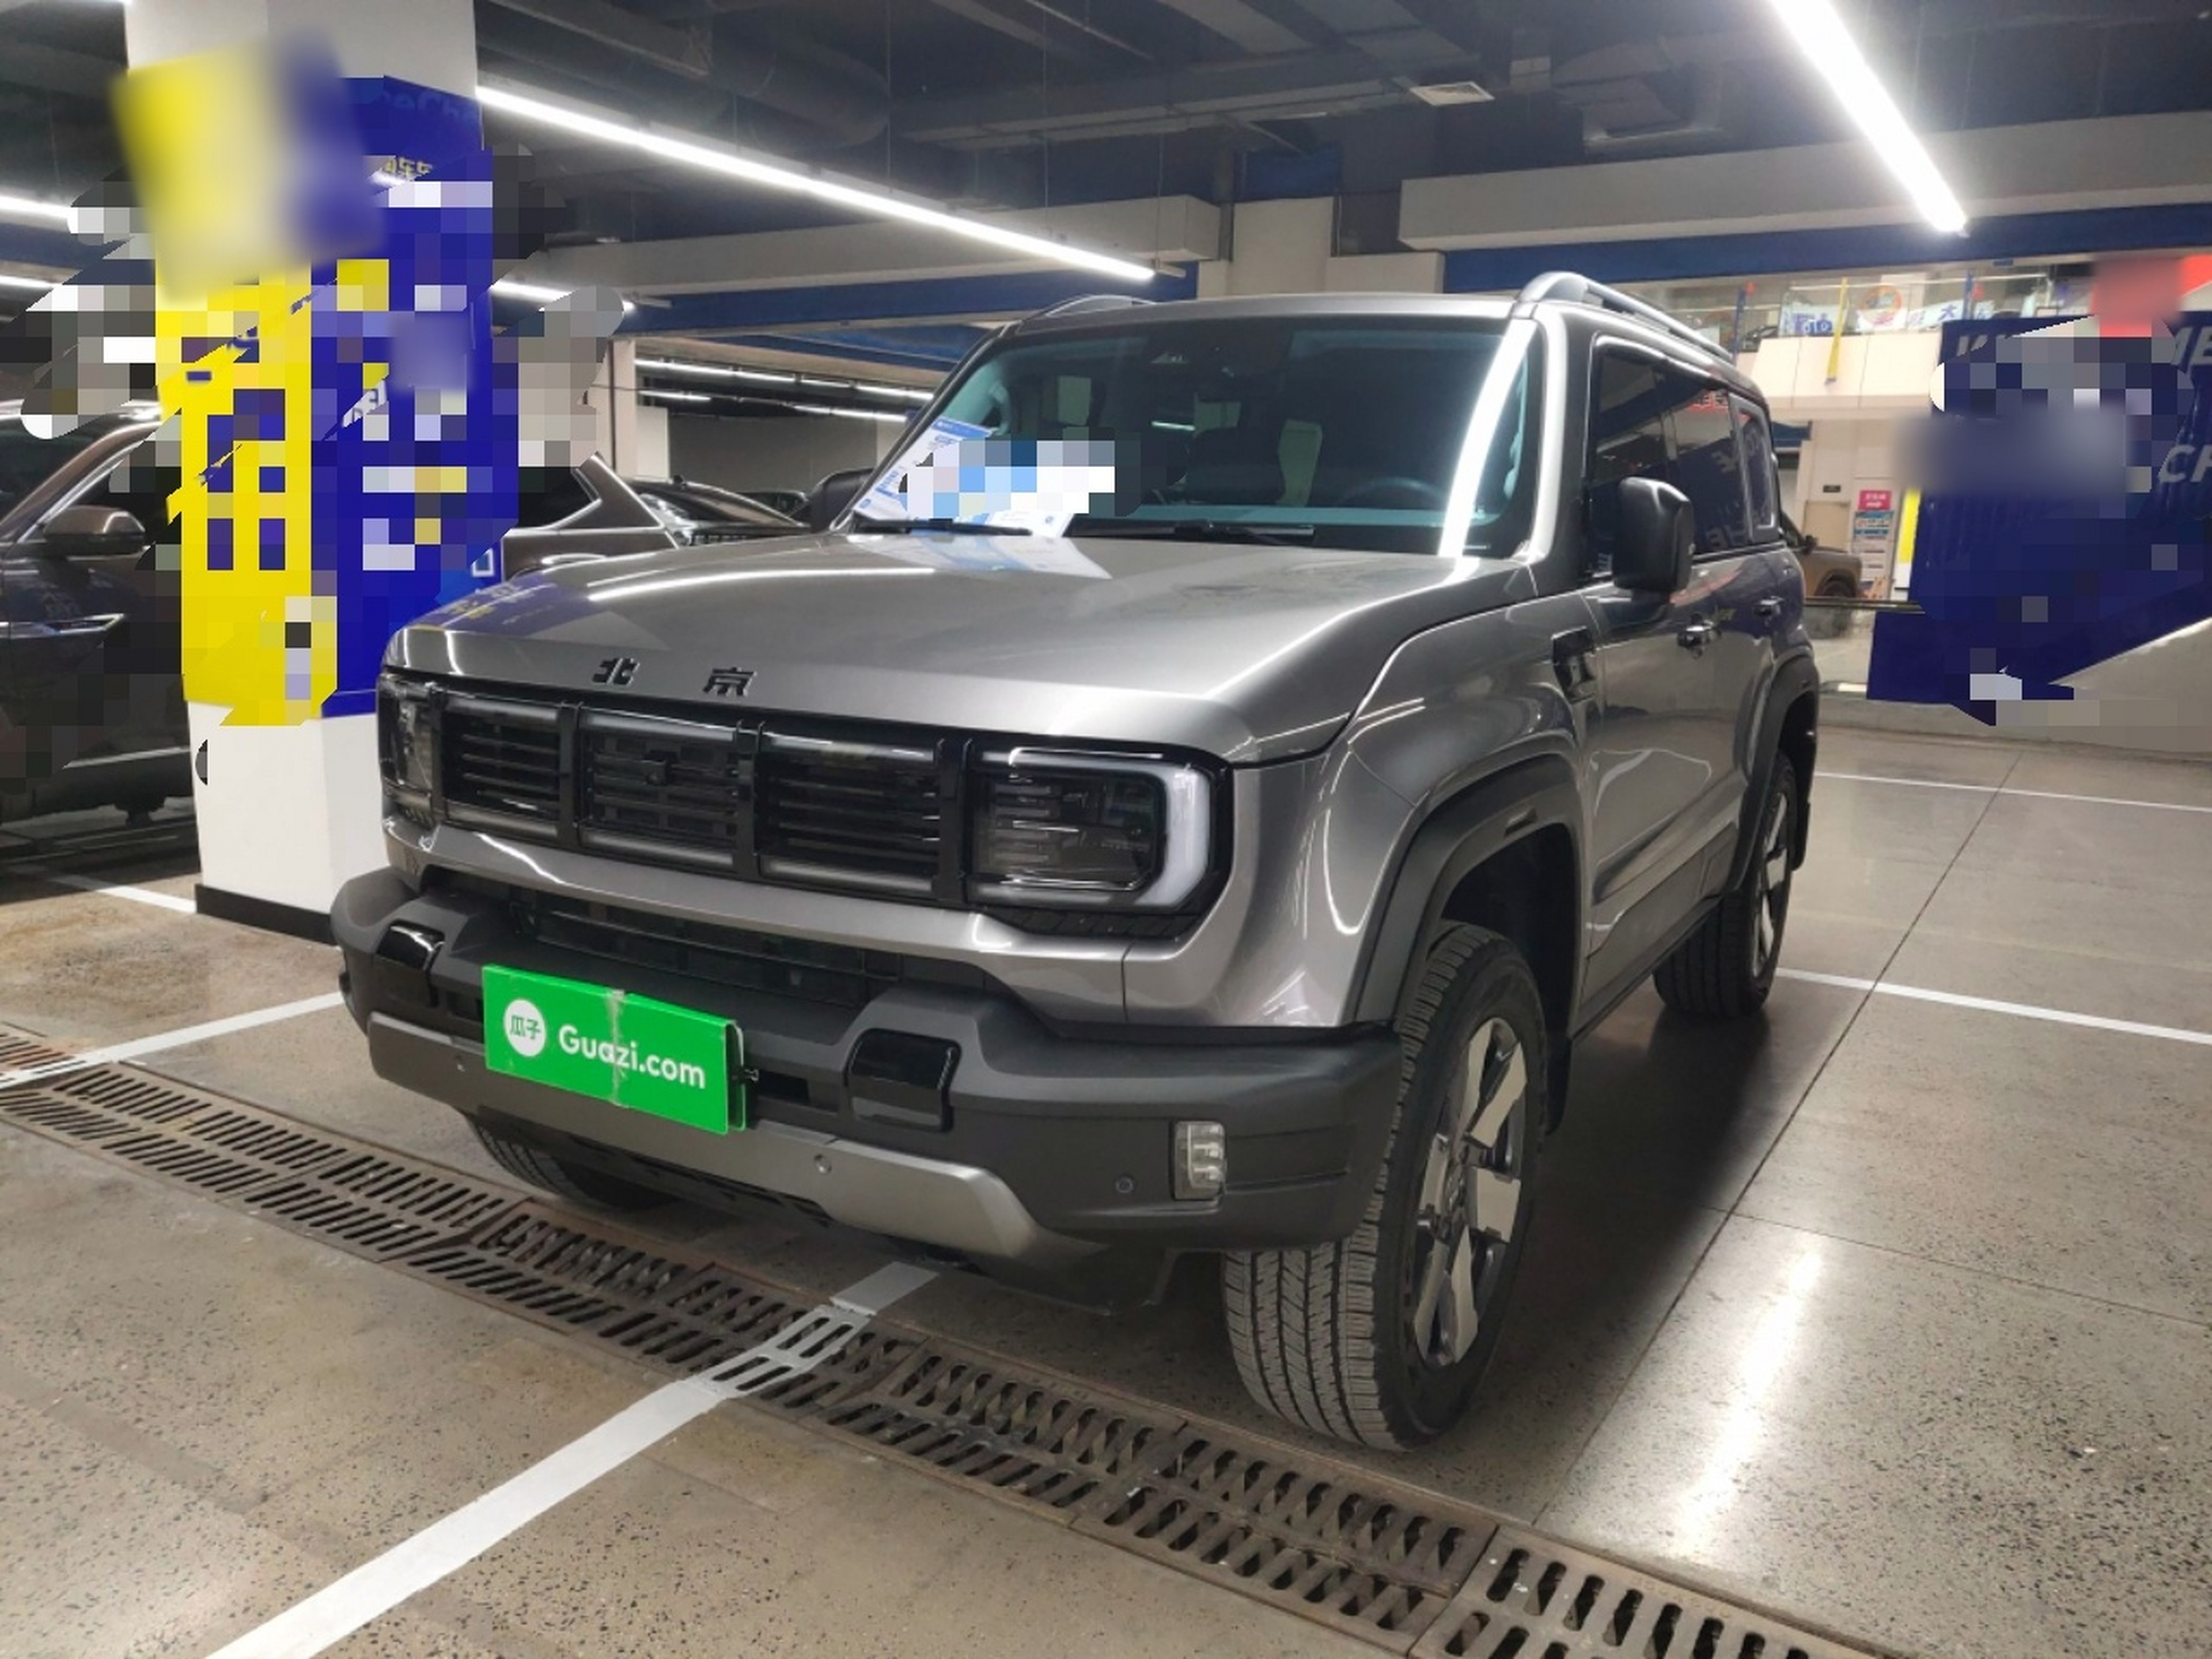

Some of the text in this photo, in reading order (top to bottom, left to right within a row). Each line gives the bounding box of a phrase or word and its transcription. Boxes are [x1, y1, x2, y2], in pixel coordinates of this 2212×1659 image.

[592, 657, 756, 696] 北京
[509, 1014, 706, 1089] 瓜子 Guazi.com
